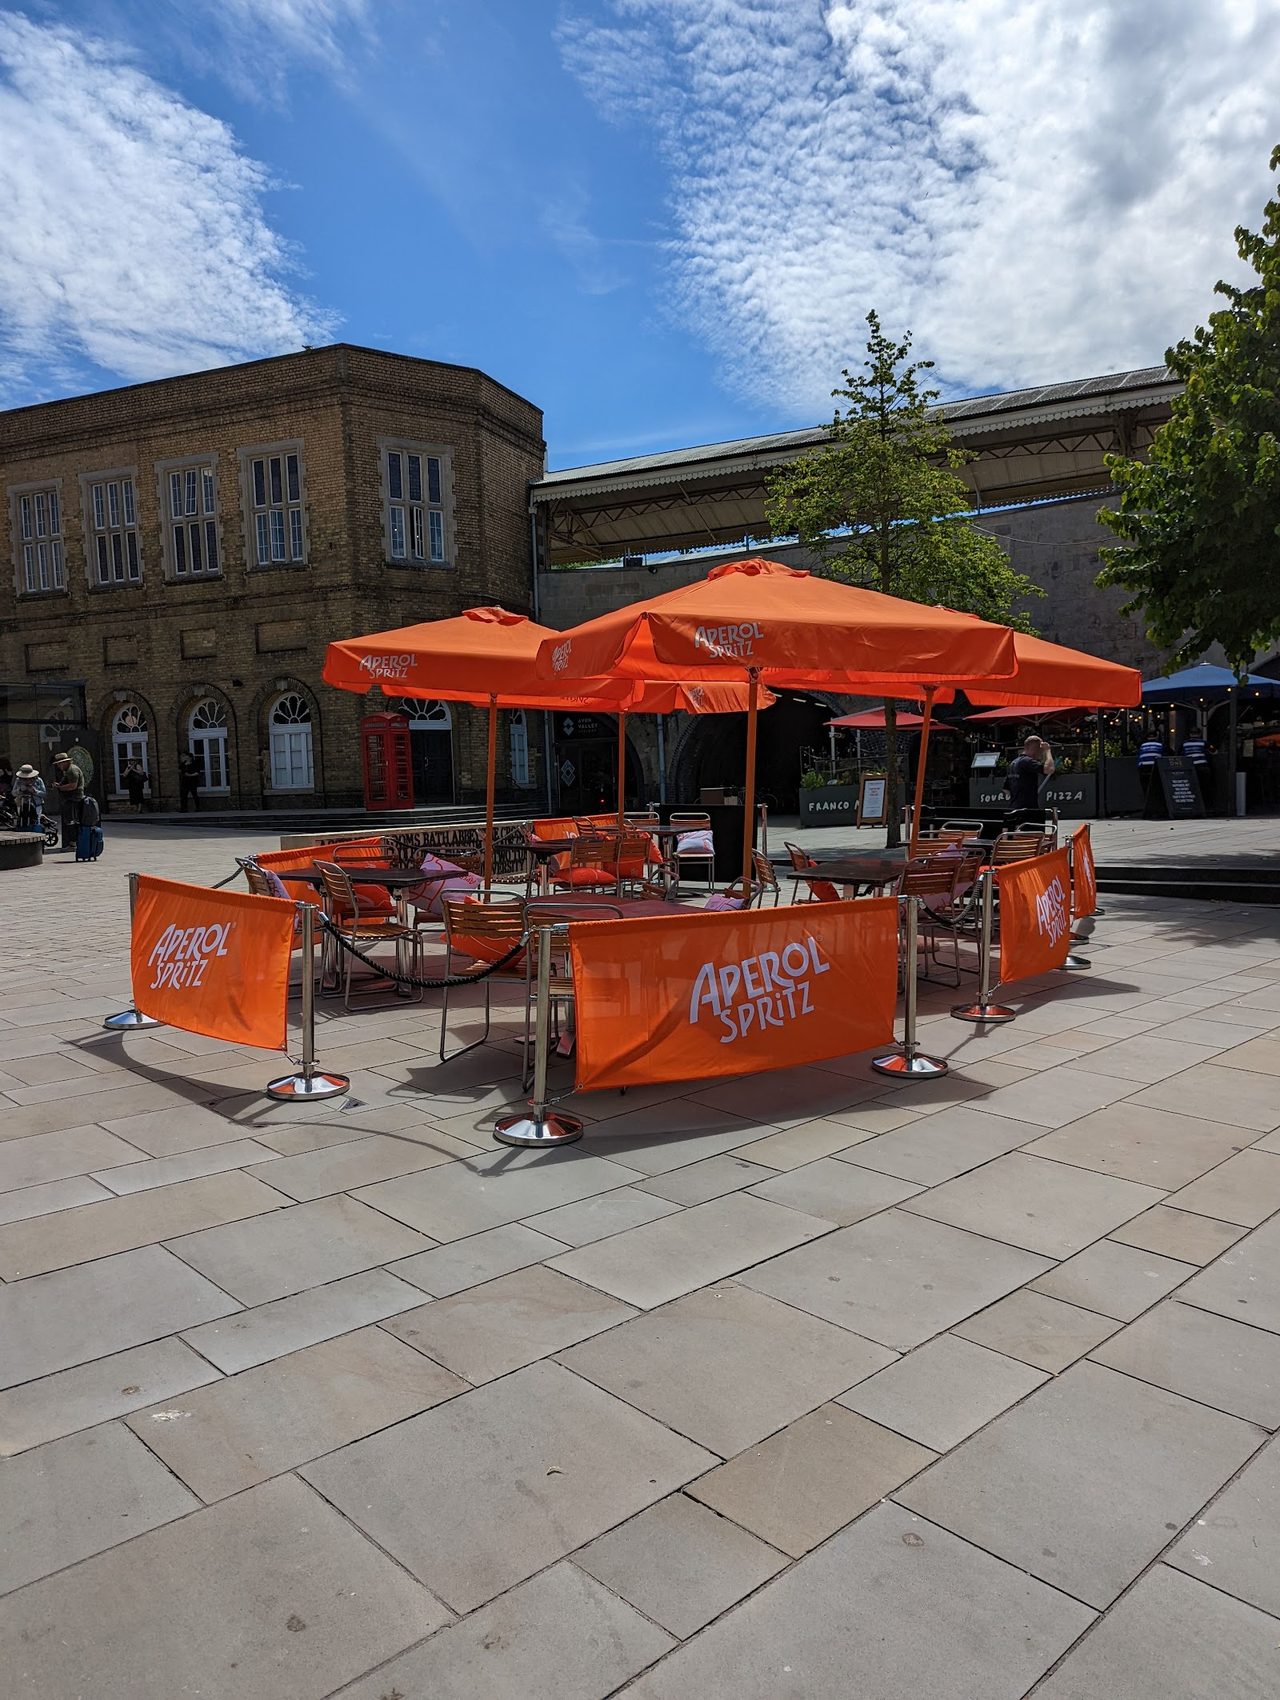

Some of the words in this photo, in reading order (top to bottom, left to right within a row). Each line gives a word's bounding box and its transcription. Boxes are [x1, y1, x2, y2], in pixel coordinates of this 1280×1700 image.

[694, 621, 764, 648] APEROL
[359, 653, 418, 671] APEROL
[808, 801, 850, 811] FRANCO
[1046, 791, 1083, 801] PIZZA
[1036, 875, 1066, 935] APEROL
[148, 922, 231, 967] APEROL
[689, 936, 831, 1024] APEROL
